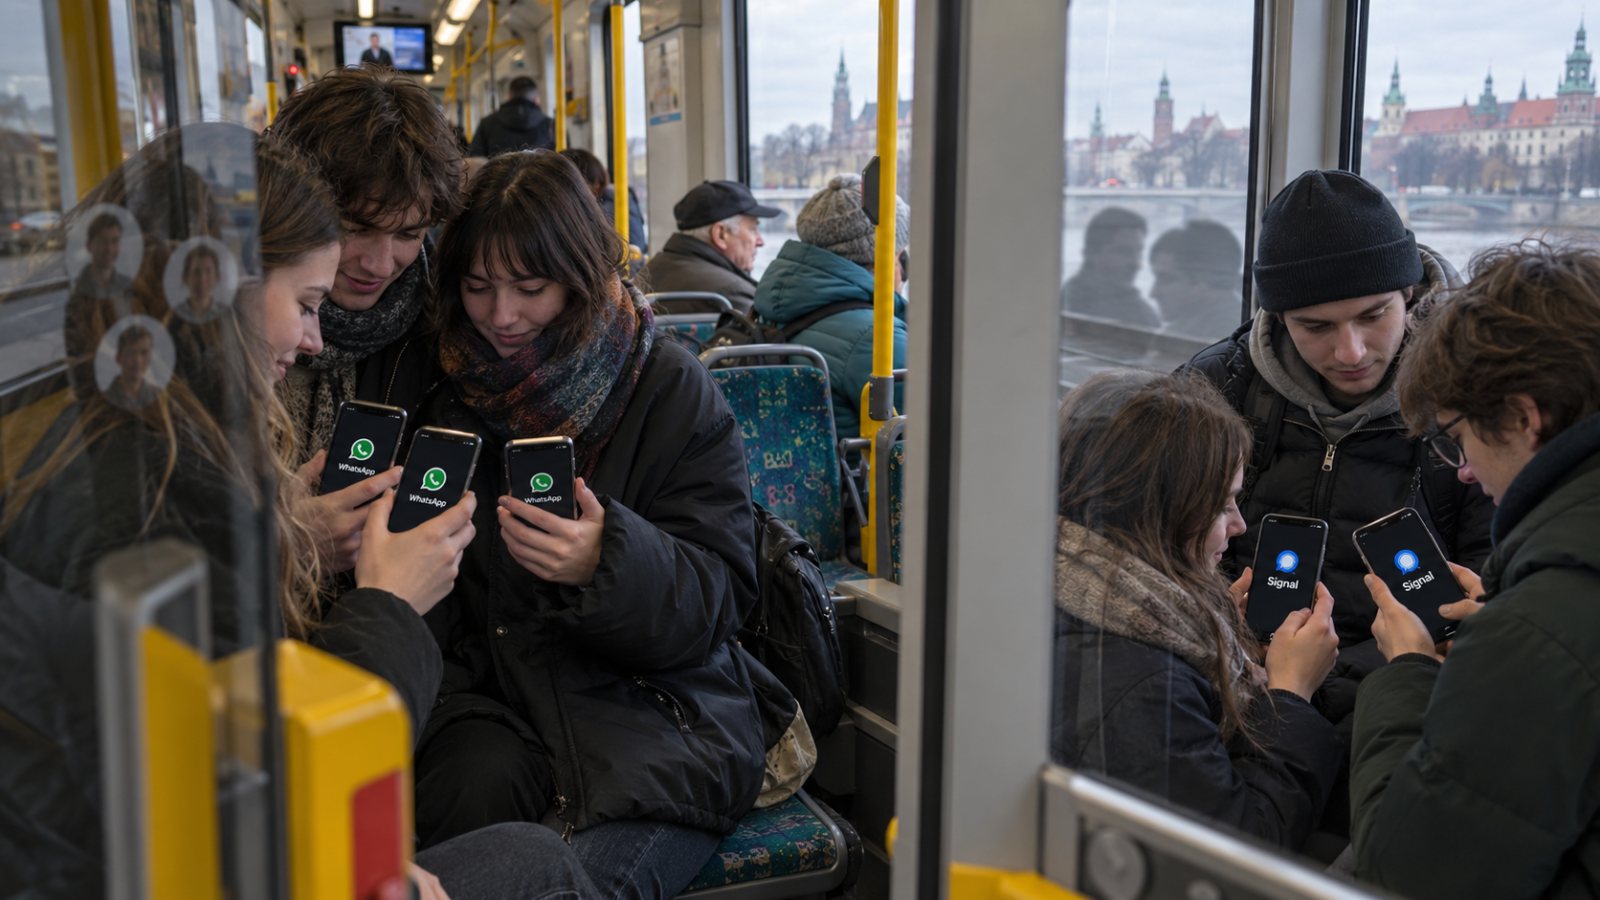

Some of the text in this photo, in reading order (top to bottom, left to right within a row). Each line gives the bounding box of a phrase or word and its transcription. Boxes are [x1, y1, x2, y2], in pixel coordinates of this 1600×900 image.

[338, 462, 376, 476] WhatsApp
[409, 493, 447, 508] WhatsApp
[524, 495, 562, 504] WhatsApp
[1267, 576, 1299, 590] Signal
[1402, 570, 1435, 592] Signal
